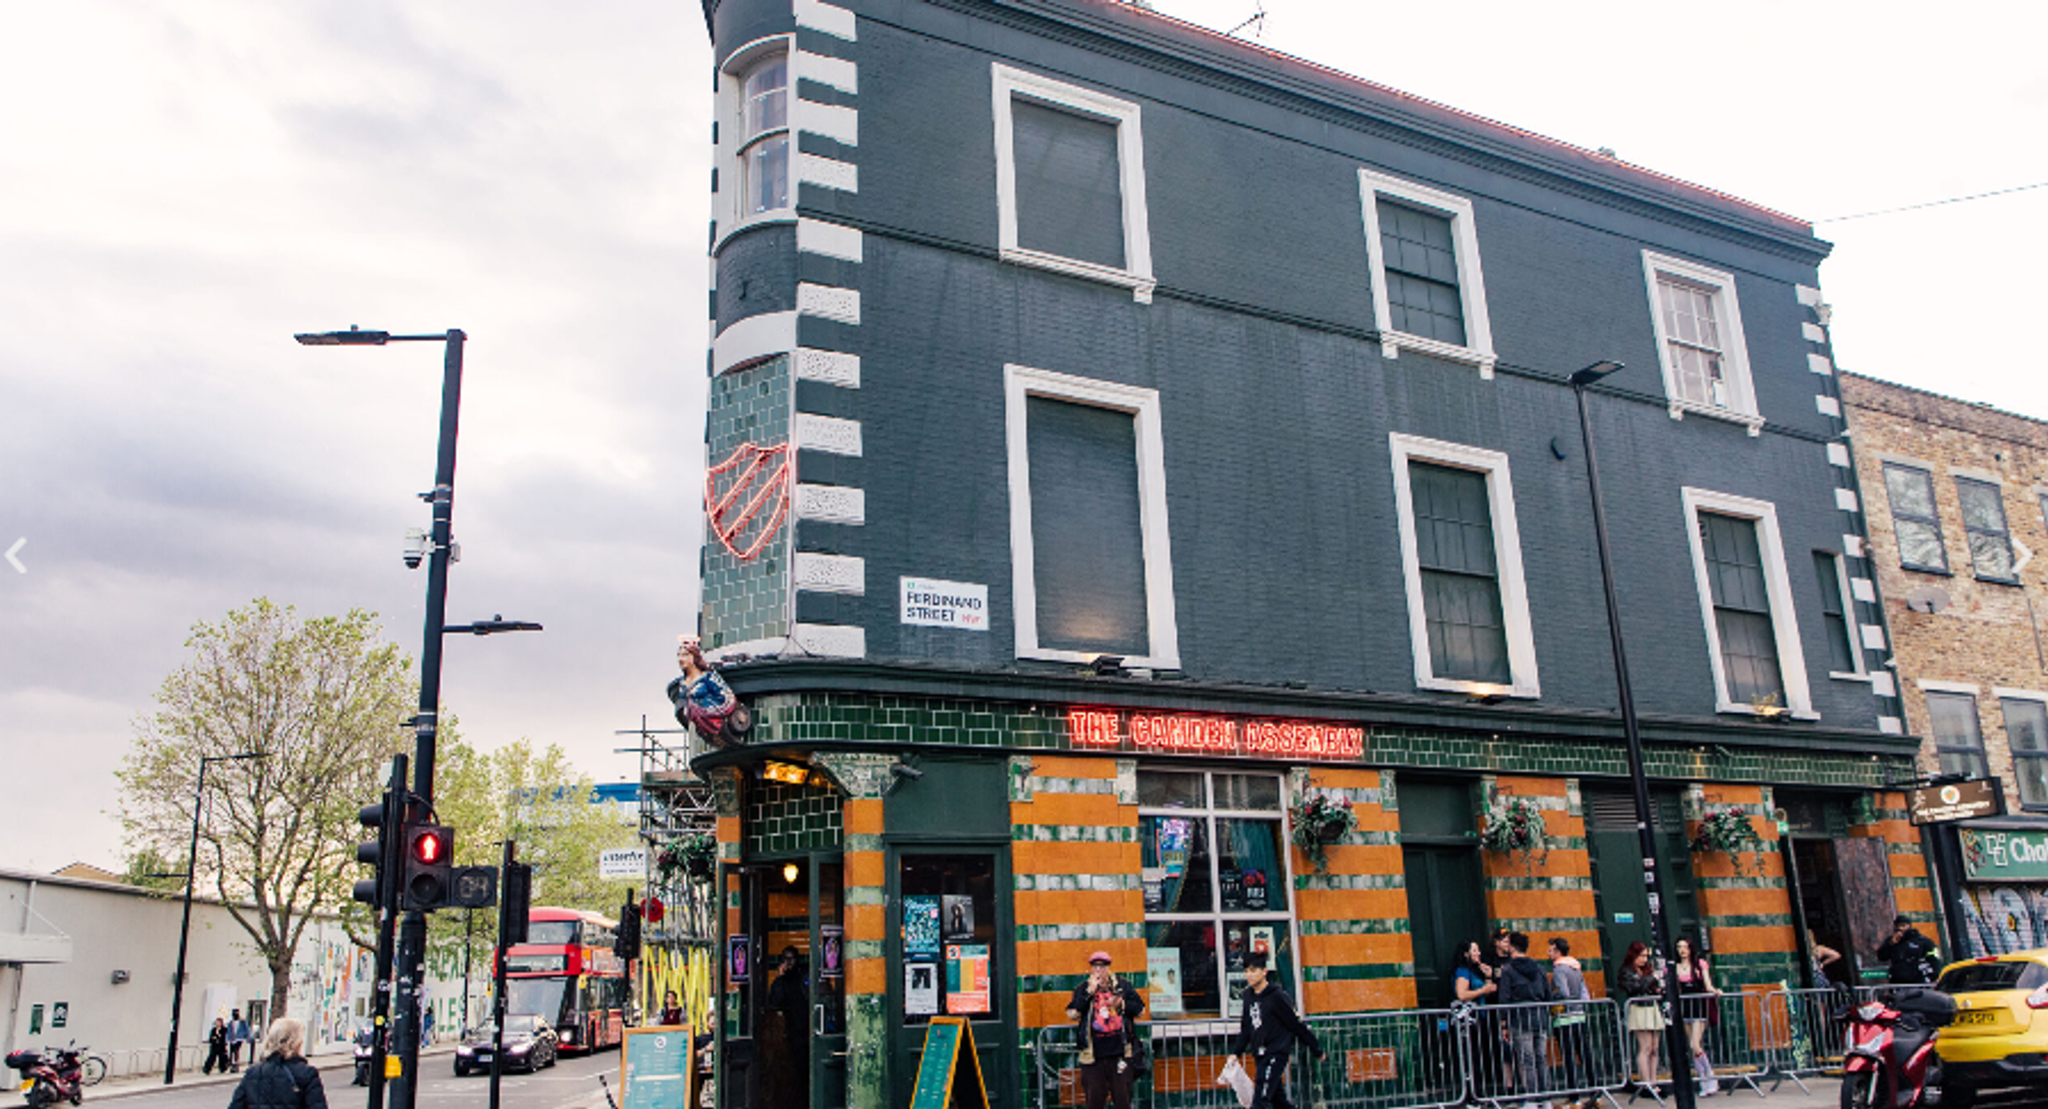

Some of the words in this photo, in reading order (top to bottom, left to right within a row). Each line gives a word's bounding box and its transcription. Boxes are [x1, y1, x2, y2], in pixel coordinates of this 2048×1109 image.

[907, 591, 982, 611] FERDINAND
[907, 607, 956, 622] STREET
[1069, 710, 1121, 743] THE
[1131, 714, 1237, 750] CAMDEN
[1246, 721, 1364, 757] ASSEMBLY
